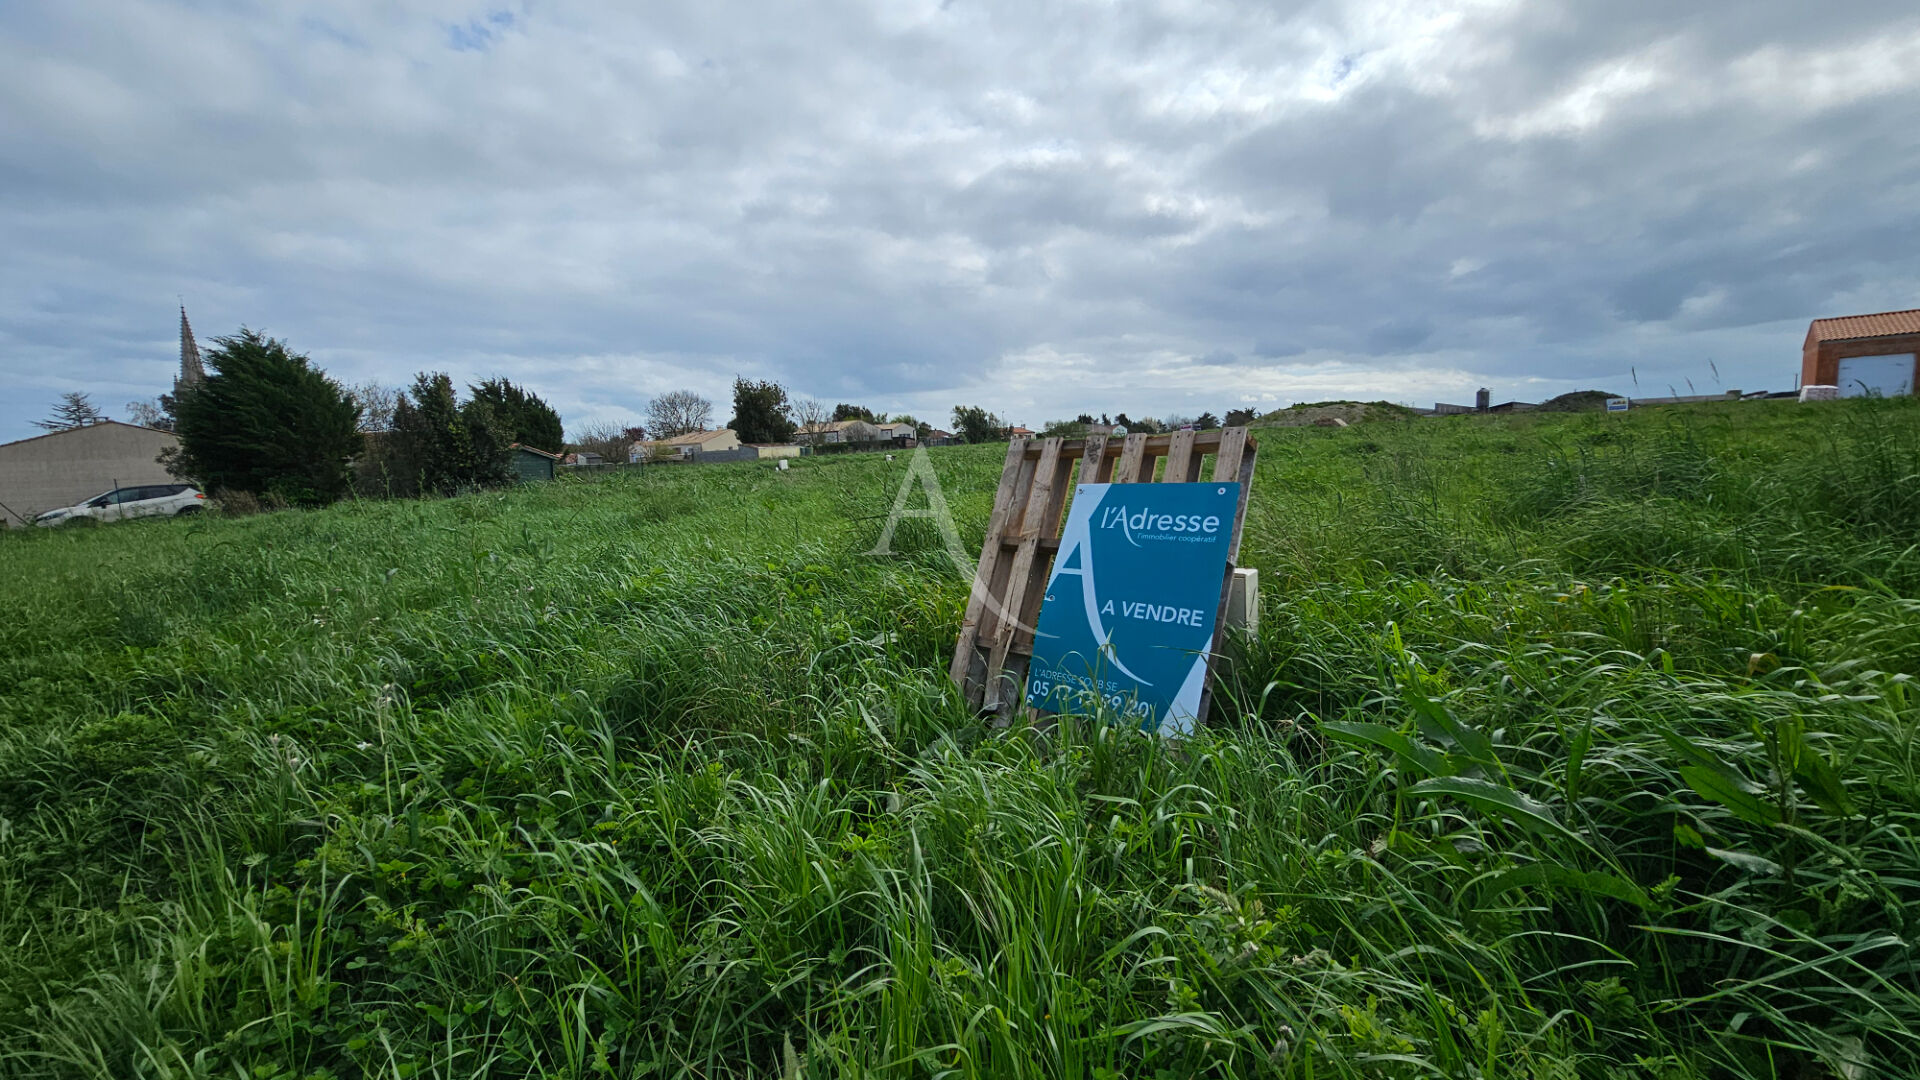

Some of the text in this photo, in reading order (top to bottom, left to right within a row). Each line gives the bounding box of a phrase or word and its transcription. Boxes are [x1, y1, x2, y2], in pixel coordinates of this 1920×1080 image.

[1100, 505, 1220, 548] l'Adresse
[1101, 599, 1205, 628] A VENDRE
[1032, 680, 1050, 697] 05
[1034, 668, 1118, 692] L'ADRESSE SOBSE
